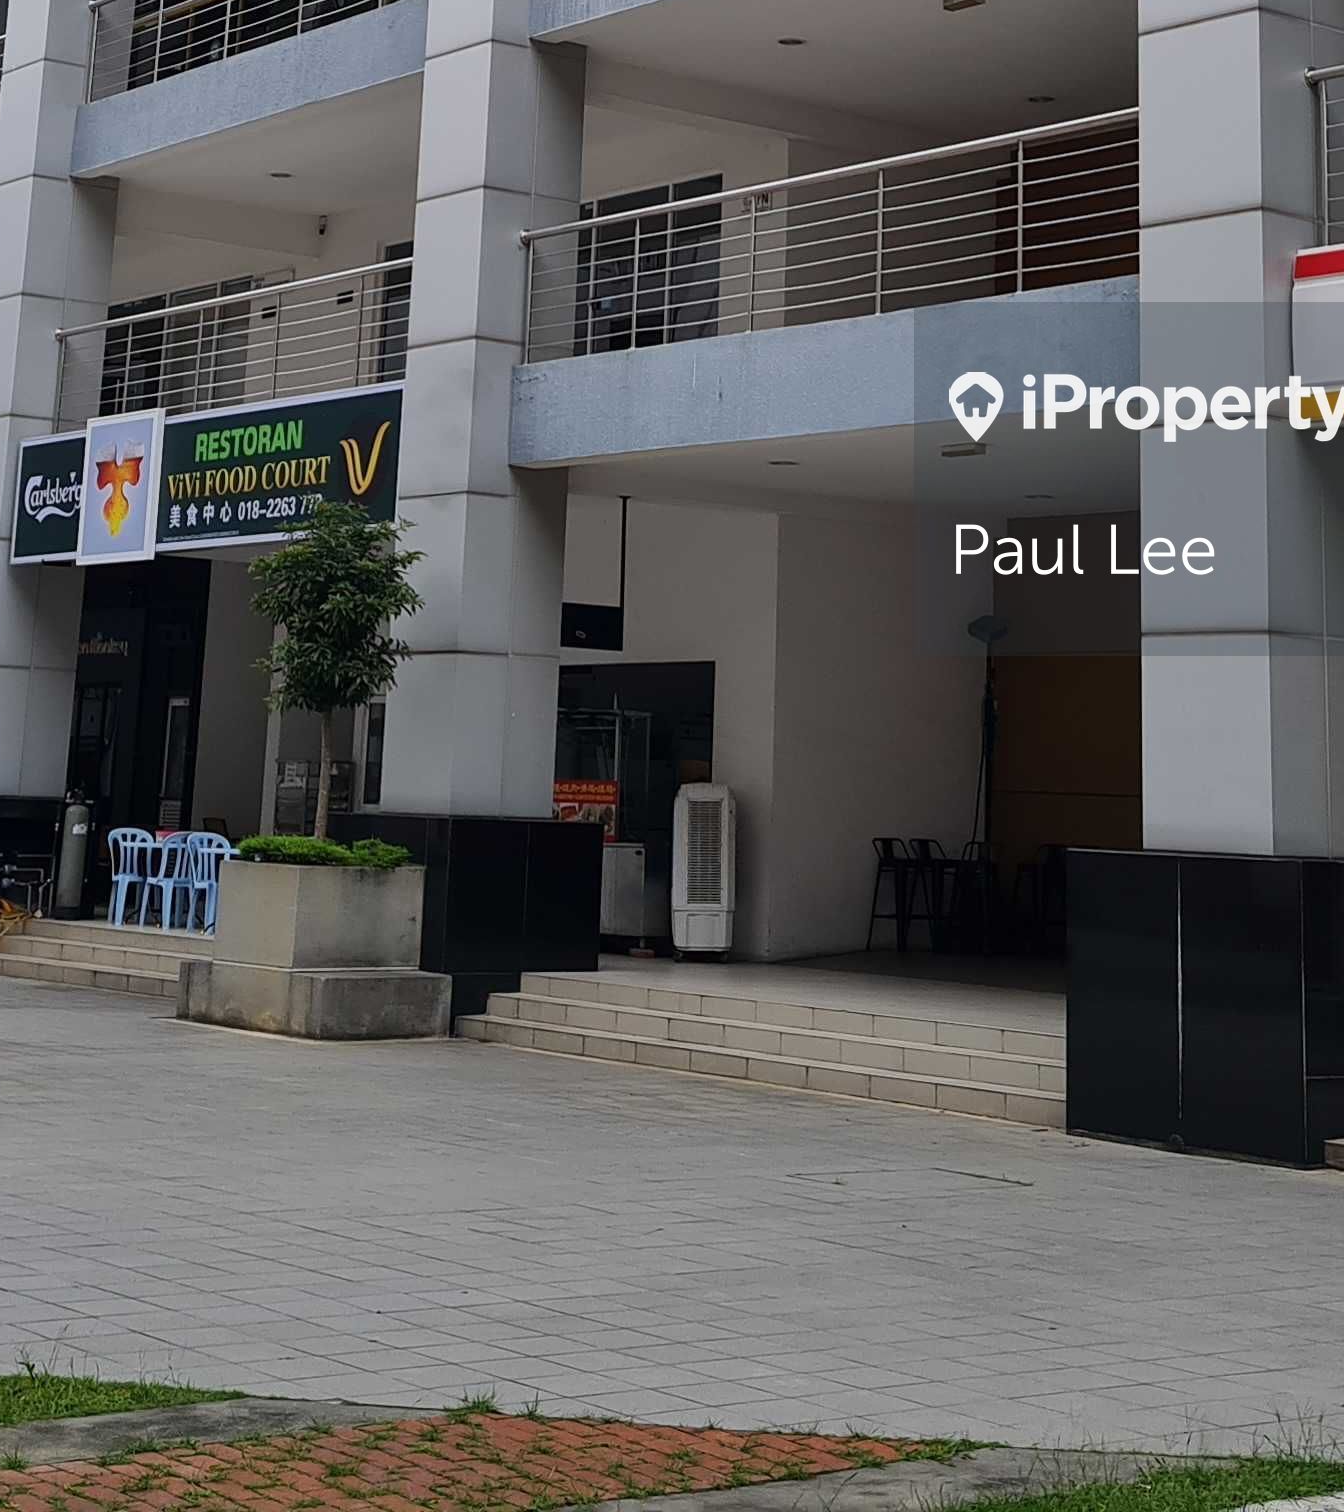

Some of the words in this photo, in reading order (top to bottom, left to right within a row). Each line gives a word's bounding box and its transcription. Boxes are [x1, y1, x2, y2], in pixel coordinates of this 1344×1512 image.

[195, 419, 303, 463] RESTORAN
[24, 473, 82, 516] Carlsberg
[204, 464, 257, 496] FOOD
[261, 455, 331, 490] COURT
[169, 501, 232, 529] 美食中心
[237, 496, 296, 521] 018-2263
